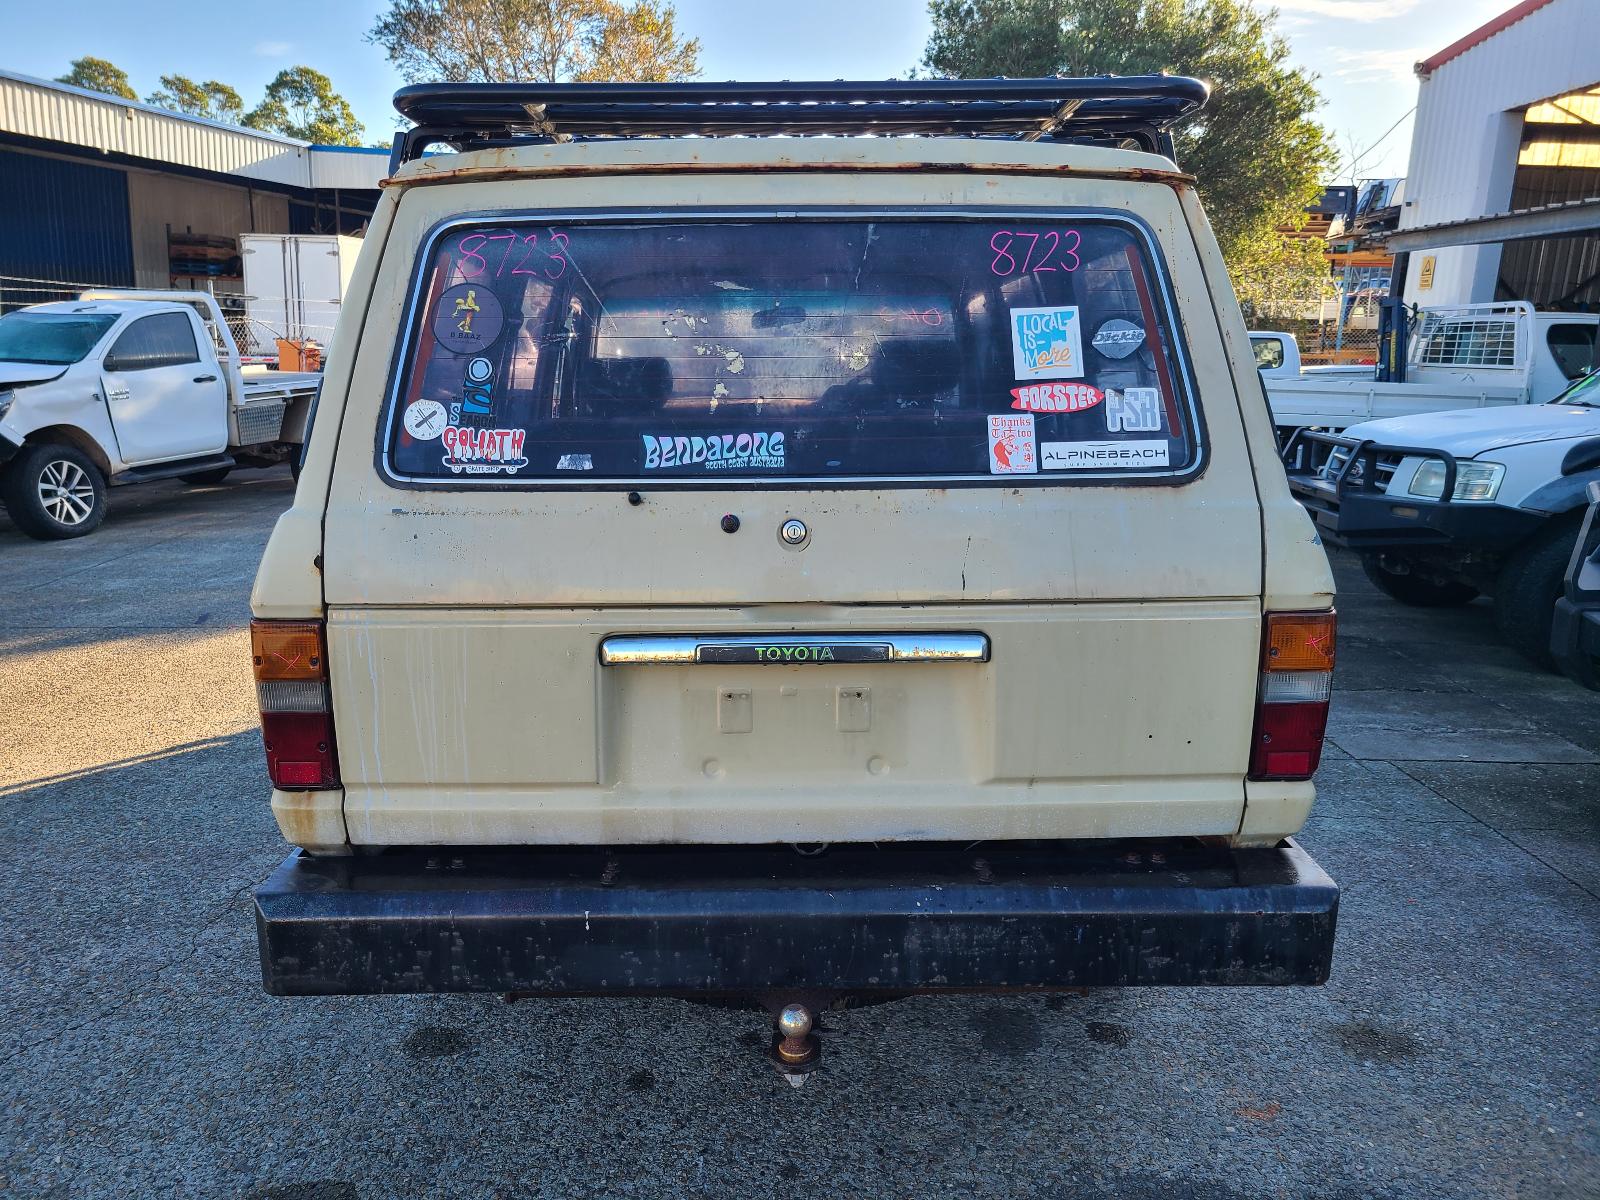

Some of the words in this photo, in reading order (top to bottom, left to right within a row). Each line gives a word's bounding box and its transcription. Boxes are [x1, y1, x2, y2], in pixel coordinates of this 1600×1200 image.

[458, 234, 569, 280] 8723
[990, 230, 1081, 276] 8723
[1024, 347, 1072, 368] More
[1018, 384, 1098, 411] FORSTER
[991, 416, 1032, 428] Thanks
[443, 427, 525, 458] GOLIATH
[705, 459, 727, 469] SOUTH
[728, 457, 749, 468] COAST
[750, 455, 785, 468] AUSTRALIA
[1044, 449, 1167, 461] ALPINEBEACH
[754, 646, 835, 661] TOYOTA
